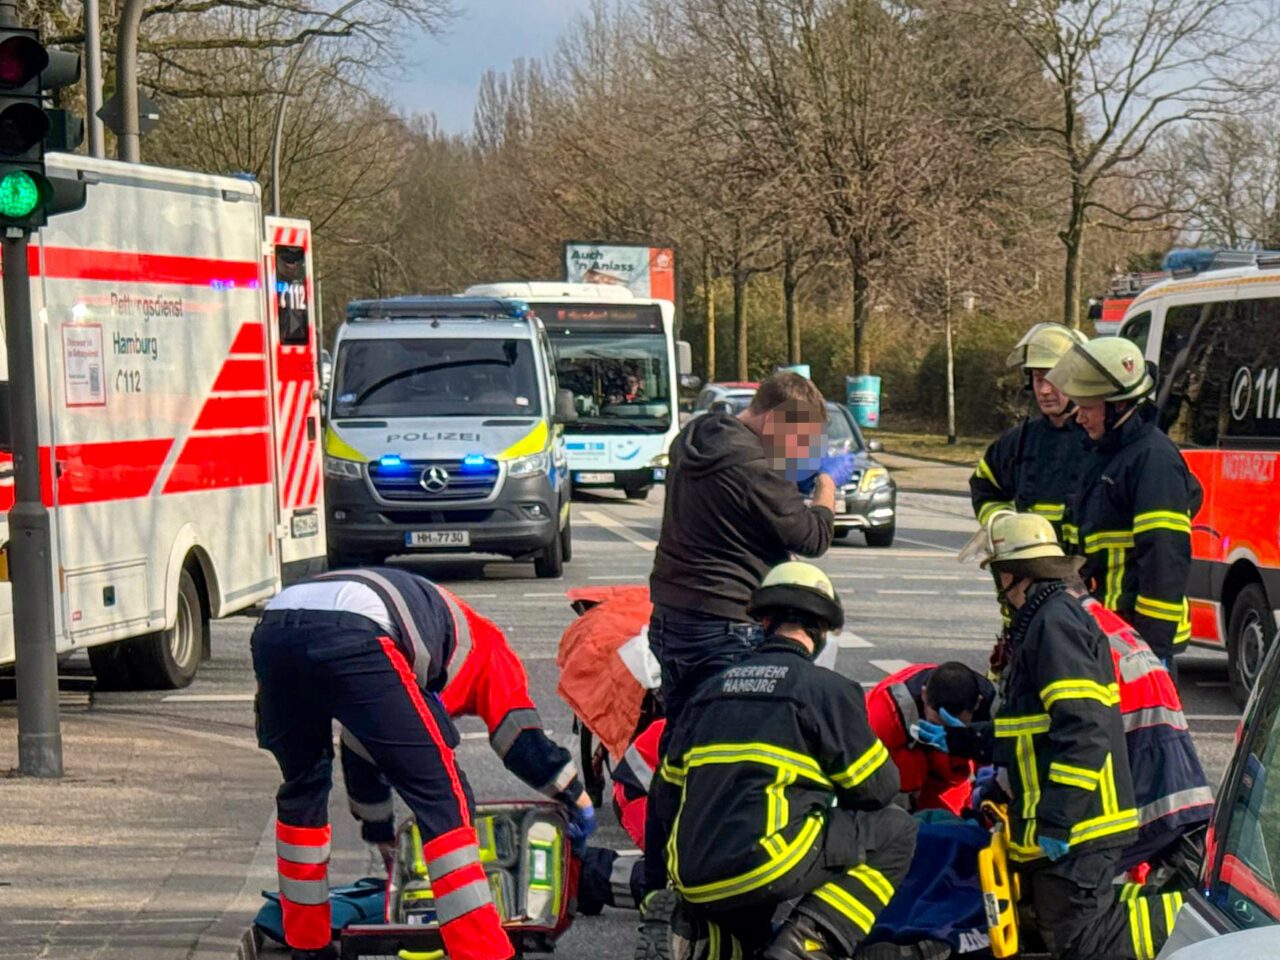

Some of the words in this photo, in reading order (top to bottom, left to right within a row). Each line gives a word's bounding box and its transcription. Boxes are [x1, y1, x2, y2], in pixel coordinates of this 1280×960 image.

[571, 250, 603, 260] Auch
[289, 283, 306, 310] 112
[112, 331, 158, 360] Hamburg
[123, 370, 141, 392] 112
[387, 433, 481, 443] POLIZEI
[1222, 454, 1277, 482] NOTARZT
[722, 665, 789, 679] FEUERWEHR
[722, 678, 777, 693] HAMBURG
